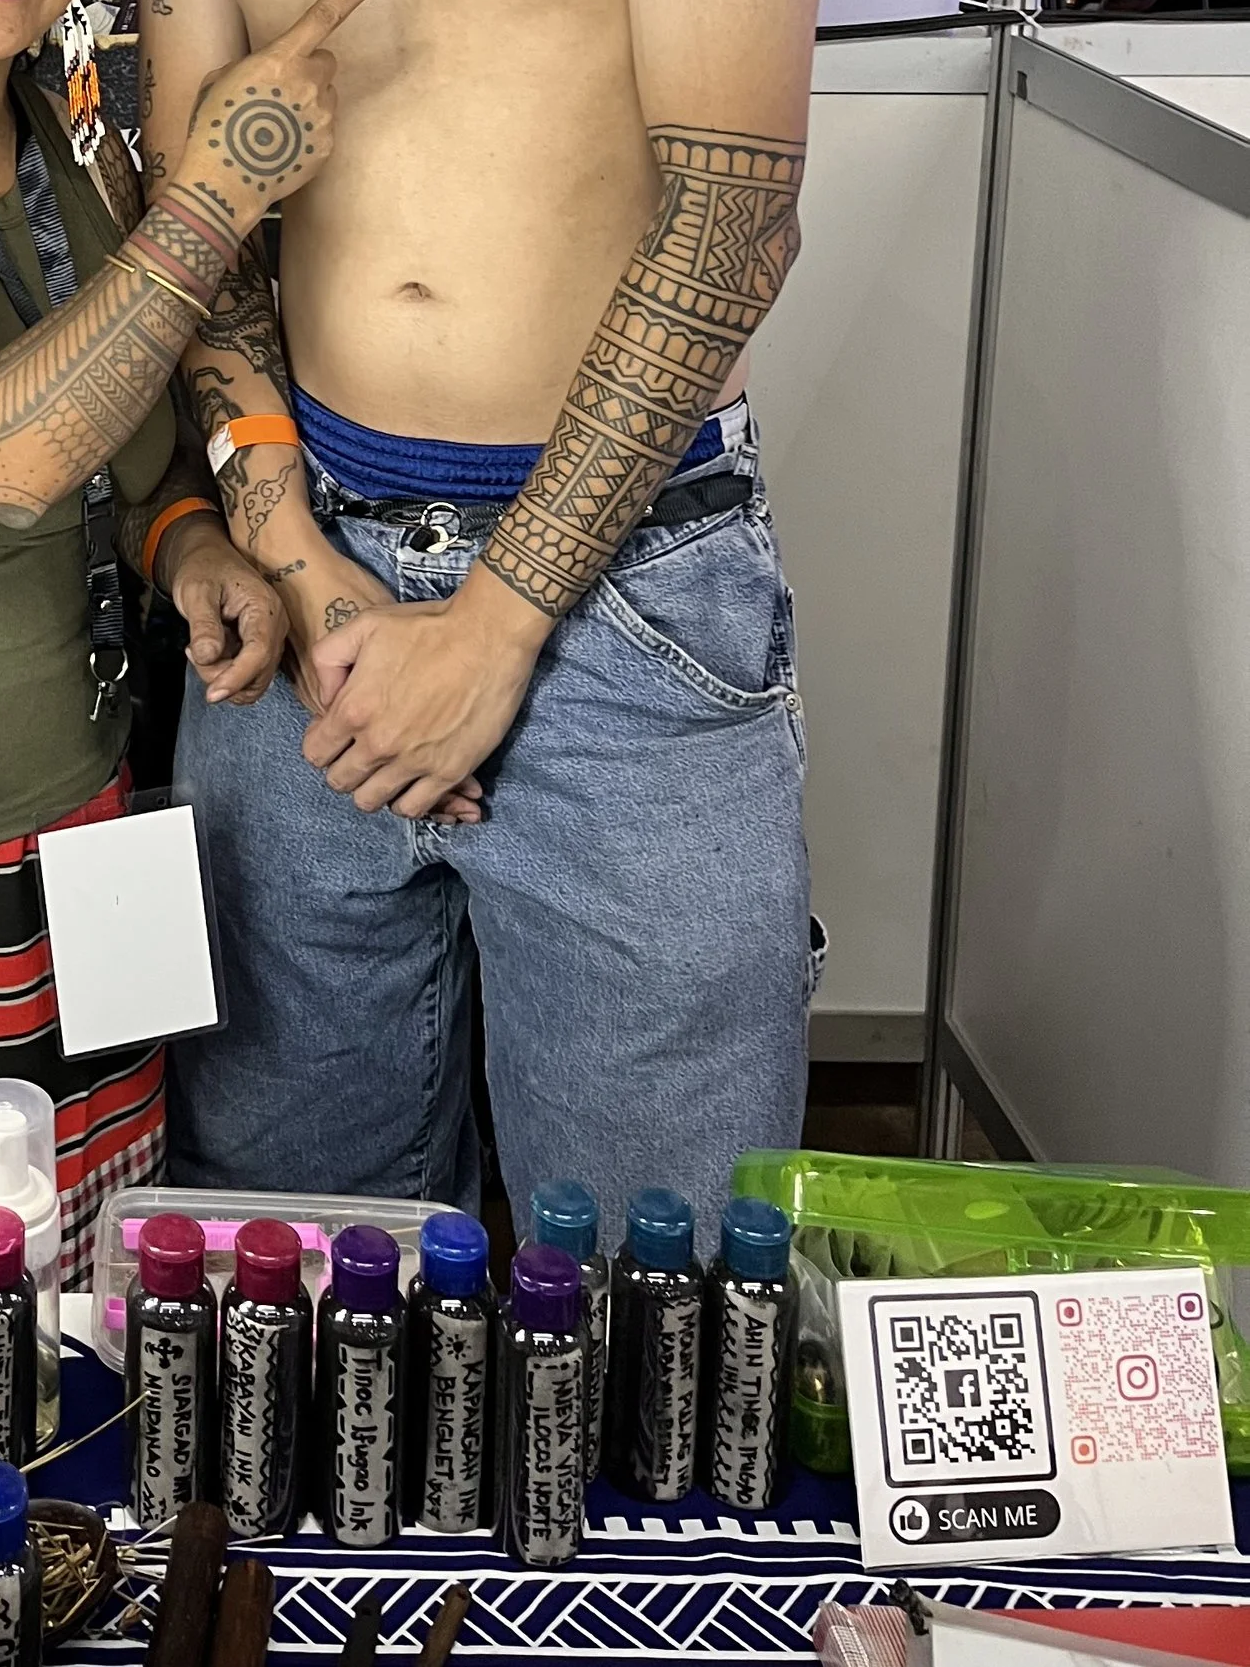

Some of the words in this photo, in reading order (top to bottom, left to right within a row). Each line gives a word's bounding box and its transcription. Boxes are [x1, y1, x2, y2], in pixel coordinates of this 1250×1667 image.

[236, 1342, 257, 1438] KABAYAN
[733, 1365, 749, 1394] INK
[143, 1370, 163, 1478] MINDANAO
[434, 1375, 458, 1481] BENGUET
[461, 1359, 485, 1482] KAPANGAN
[532, 1405, 552, 1473] ILOCOS
[551, 1378, 574, 1447] NUEVA
[235, 1449, 254, 1487] INK
[348, 1500, 376, 1532] Ink
[456, 1489, 478, 1525] INK
[532, 1481, 552, 1542] NORTE
[938, 1507, 998, 1531] SCAN
[1004, 1505, 1038, 1527] ME
